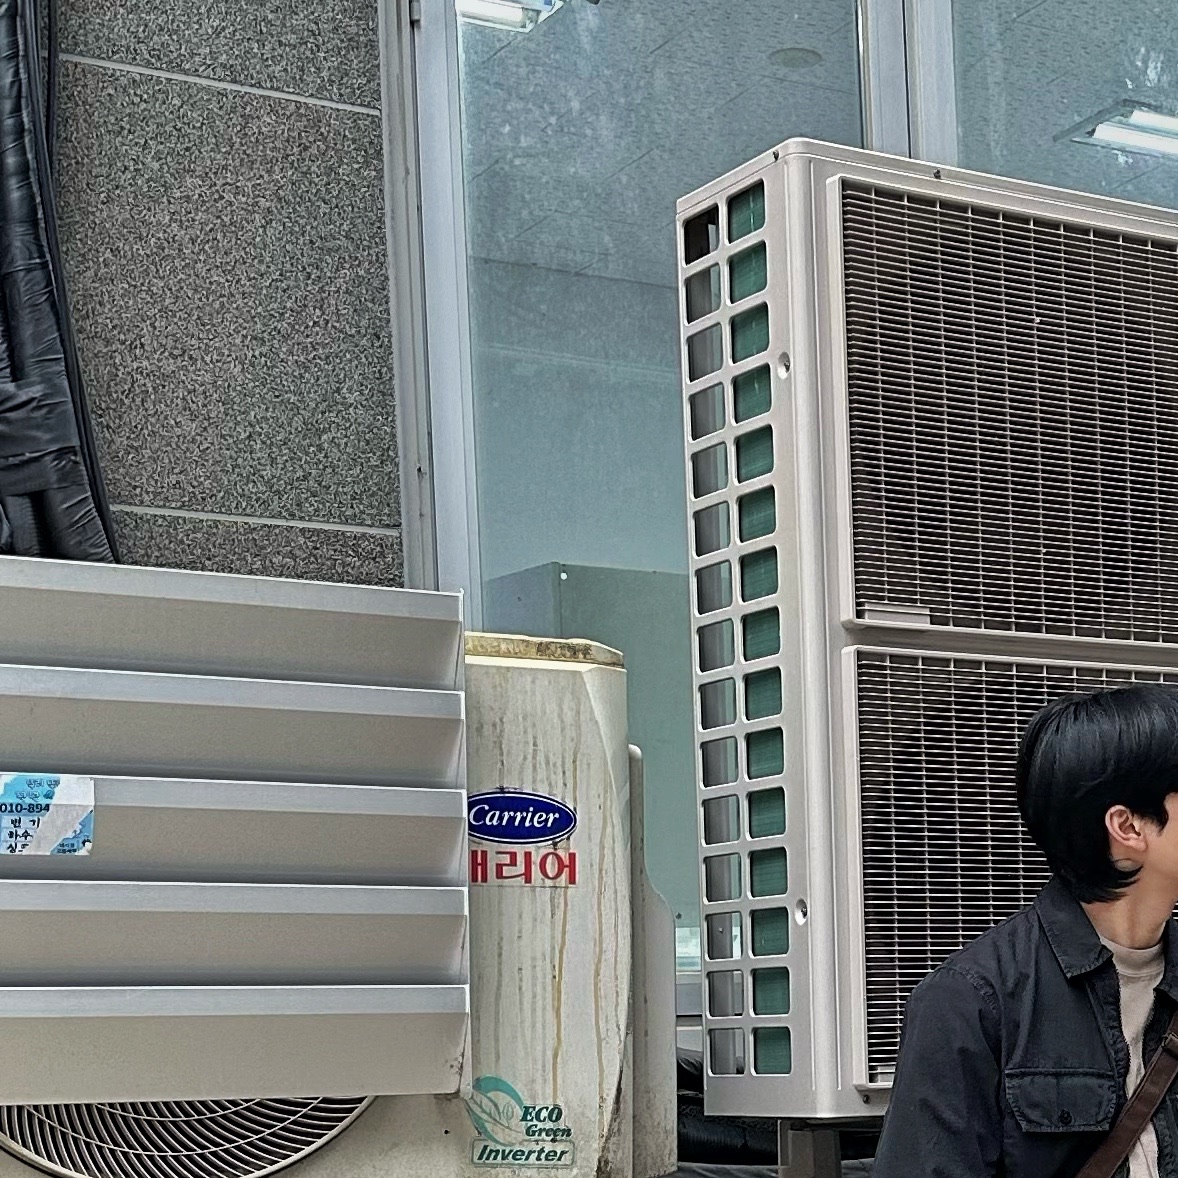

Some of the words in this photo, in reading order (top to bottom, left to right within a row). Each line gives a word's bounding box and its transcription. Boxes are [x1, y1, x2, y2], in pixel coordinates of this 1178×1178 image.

[469, 804, 560, 828] Carrier
[520, 1105, 563, 1122] ECO
[525, 1124, 573, 1138] Green
[477, 1144, 570, 1162] Inverter
